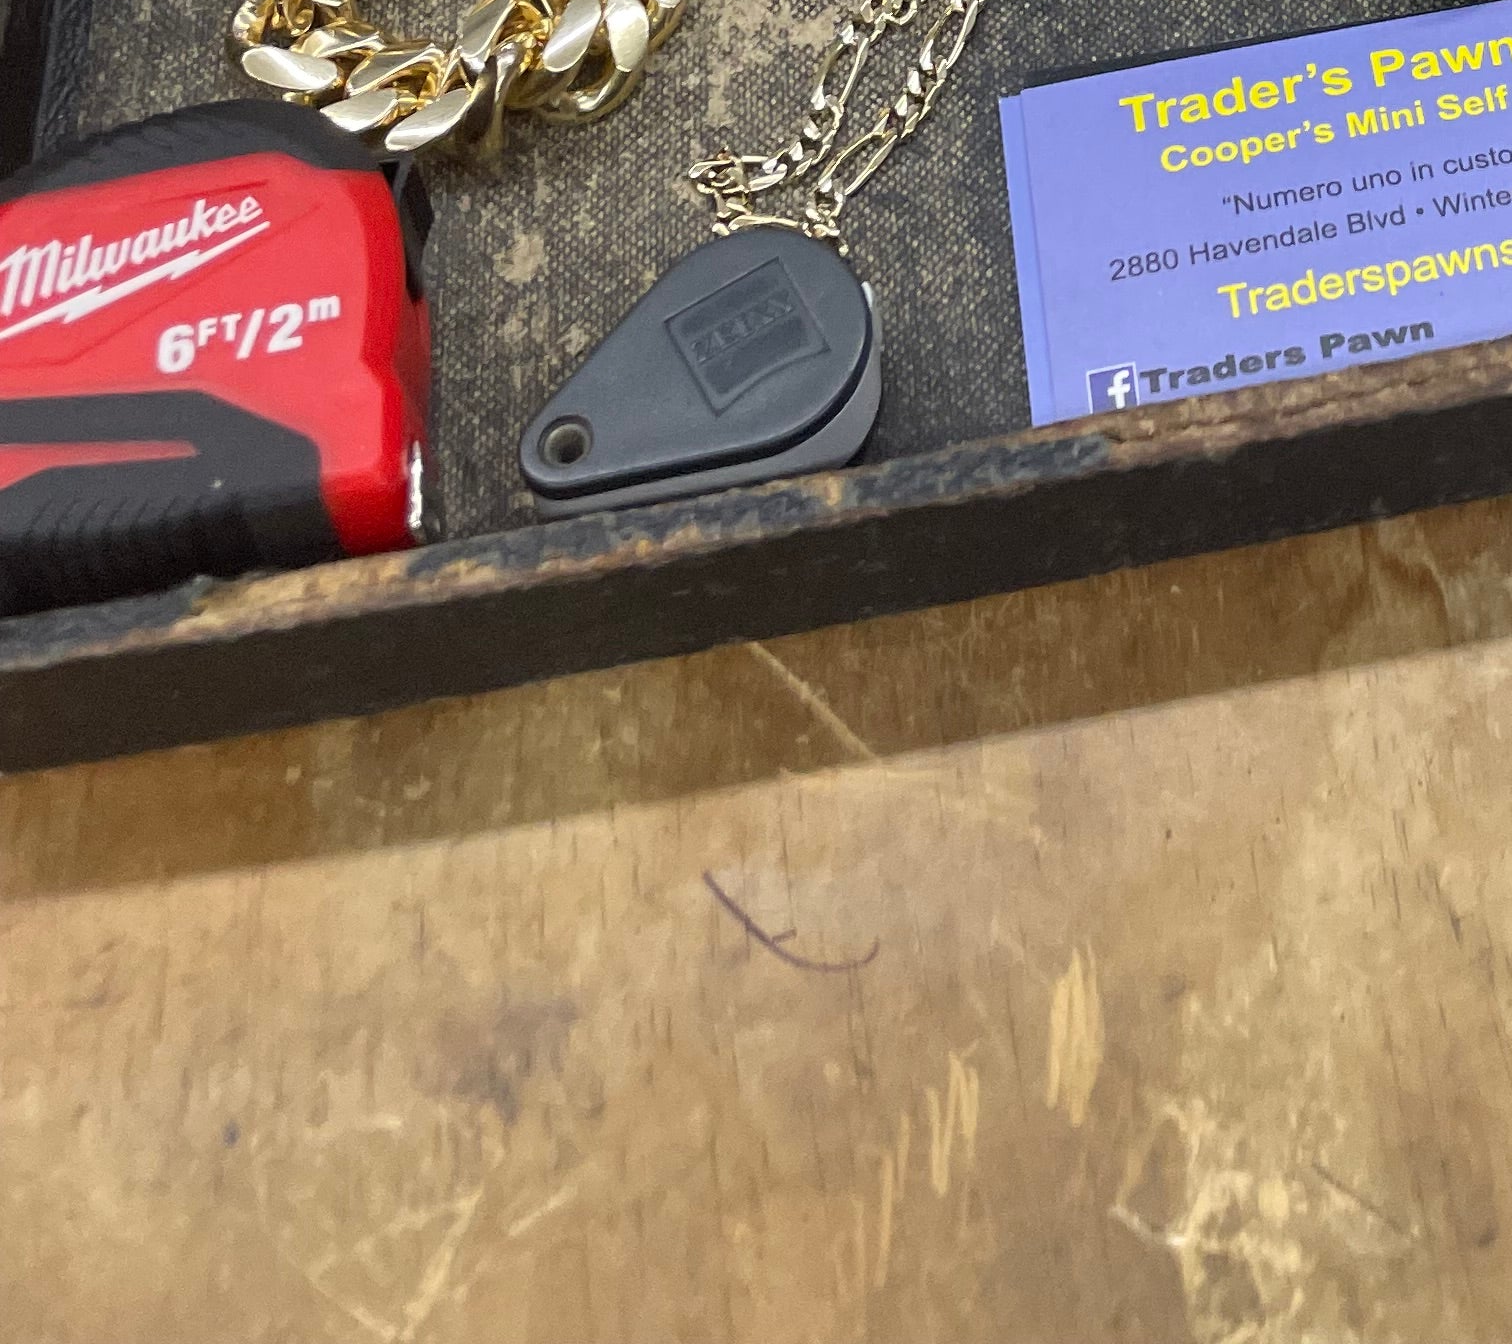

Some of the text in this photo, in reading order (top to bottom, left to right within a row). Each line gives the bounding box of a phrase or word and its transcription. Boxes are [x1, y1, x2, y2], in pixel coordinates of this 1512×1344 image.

[1118, 61, 1354, 134] Trader’s
[1159, 120, 1336, 173] Cooper’s
[1346, 100, 1426, 139] Mini
[1436, 83, 1508, 123] Self
[1352, 168, 1402, 193] uno
[1410, 160, 1434, 182] in
[0, 195, 264, 313] Milwaukee
[1110, 248, 1180, 282] 2880
[1189, 220, 1338, 265] Havendale
[1346, 205, 1406, 235] Blvd
[1139, 344, 1307, 395] Traders
[1319, 320, 1435, 359] Pawn
